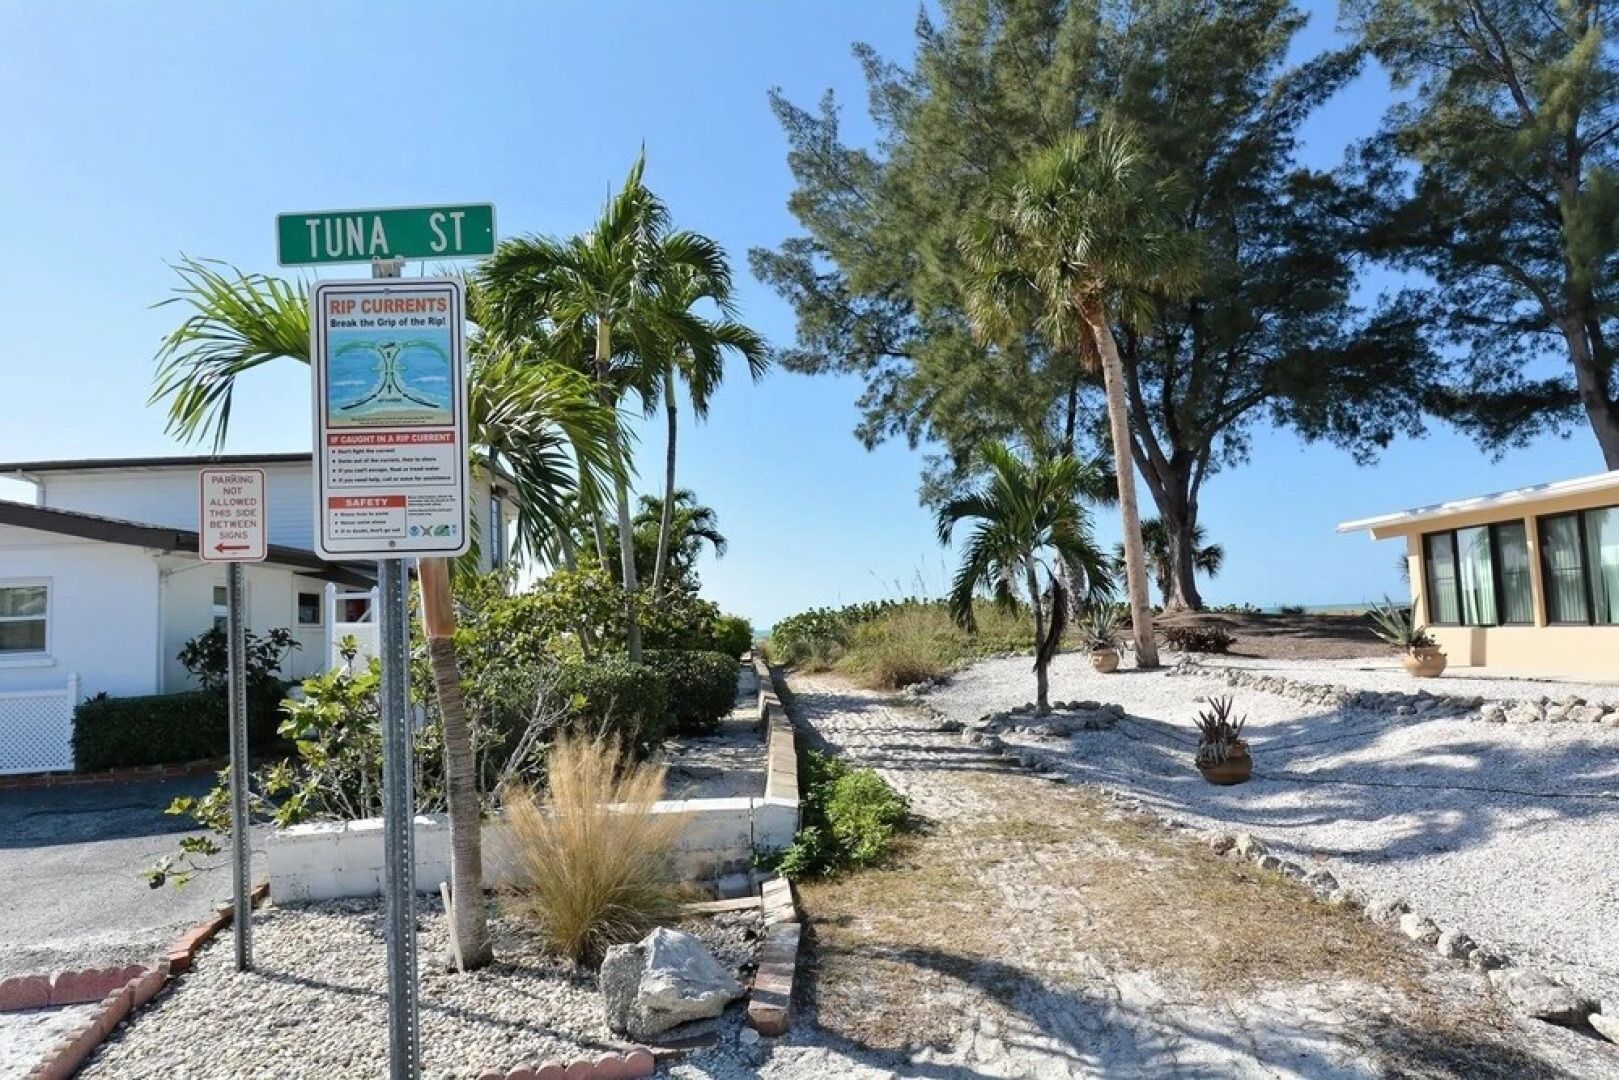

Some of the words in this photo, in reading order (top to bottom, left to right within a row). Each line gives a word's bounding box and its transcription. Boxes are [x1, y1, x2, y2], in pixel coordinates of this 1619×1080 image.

[305, 216, 389, 257] TUNA
[429, 211, 465, 252] ST
[330, 299, 356, 314] RIP
[361, 298, 448, 313] CURRENTS
[330, 318, 358, 328] Break
[360, 318, 374, 327] the
[376, 318, 398, 328] Grip
[398, 317, 408, 326] of
[410, 317, 426, 326] the
[428, 316, 446, 327] Rip!
[341, 435, 375, 444] CAUGHT
[396, 434, 411, 442] RIP
[411, 434, 450, 442] CURRENT
[212, 476, 254, 484] PARKING
[346, 498, 388, 507] SAFETY
[236, 508, 256, 517] SIDE
[220, 531, 248, 539] SIGNS
